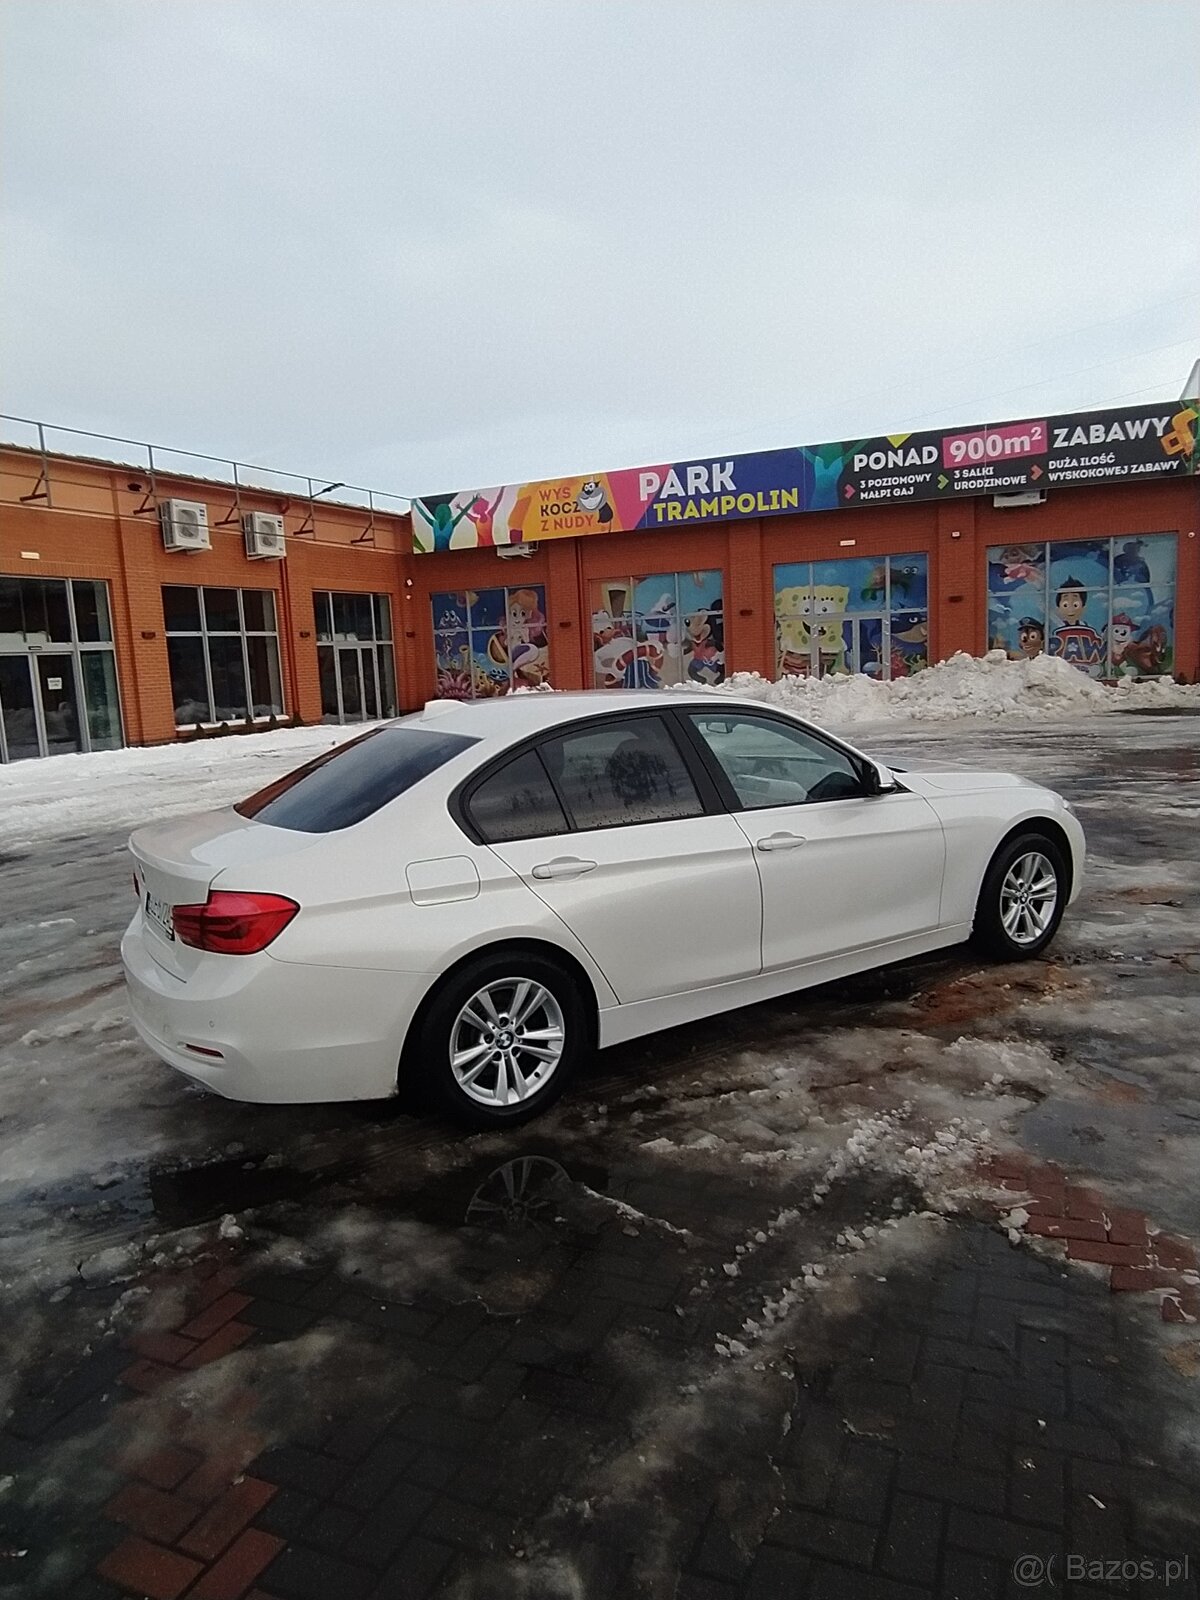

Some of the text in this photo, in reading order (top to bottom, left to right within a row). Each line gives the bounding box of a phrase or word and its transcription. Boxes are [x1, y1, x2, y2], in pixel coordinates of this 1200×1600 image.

[853, 446, 939, 472] PONAD
[1053, 416, 1171, 448] ZABAWY
[1048, 452, 1115, 469] DUŻA ILOŚĆ
[954, 466, 994, 478] 3 SALKI
[1048, 460, 1180, 481] WYSKOKOWEJ ZABAWY
[639, 461, 737, 501] PARK
[859, 473, 932, 488] 3 POZIOMOWY
[954, 475, 1027, 490] URODZINOWE
[539, 487, 571, 501] WYS
[860, 487, 915, 500] MAŁPI GAJ
[540, 501, 581, 517] KOCZ
[653, 487, 799, 522] TRAMPOLIN
[541, 515, 593, 531] Z NUDY
